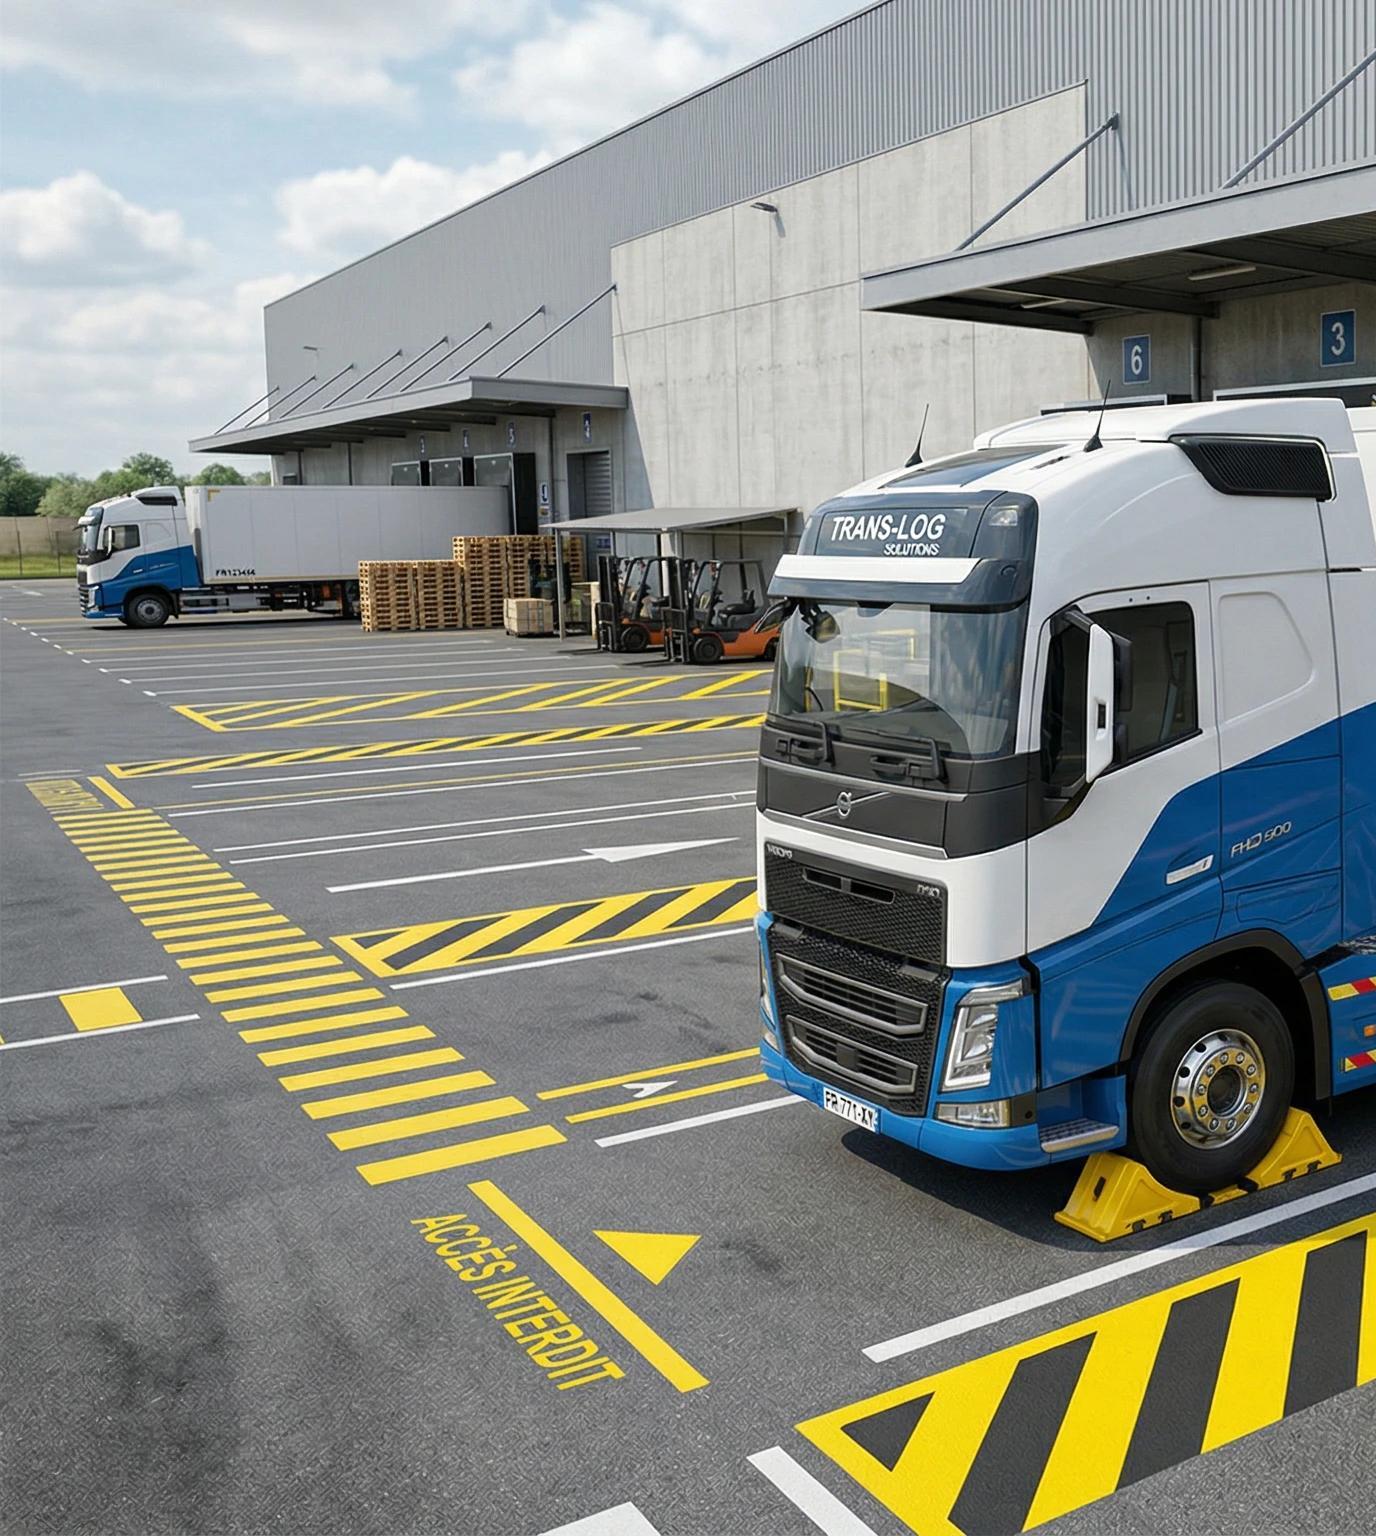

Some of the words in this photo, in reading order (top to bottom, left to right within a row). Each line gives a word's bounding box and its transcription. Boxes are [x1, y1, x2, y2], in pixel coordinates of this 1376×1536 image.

[1331, 322, 1346, 356] 3
[1130, 345, 1143, 375] 6
[831, 513, 946, 541] TRANS-LOG
[472, 1276, 625, 1391] INTERDIT
